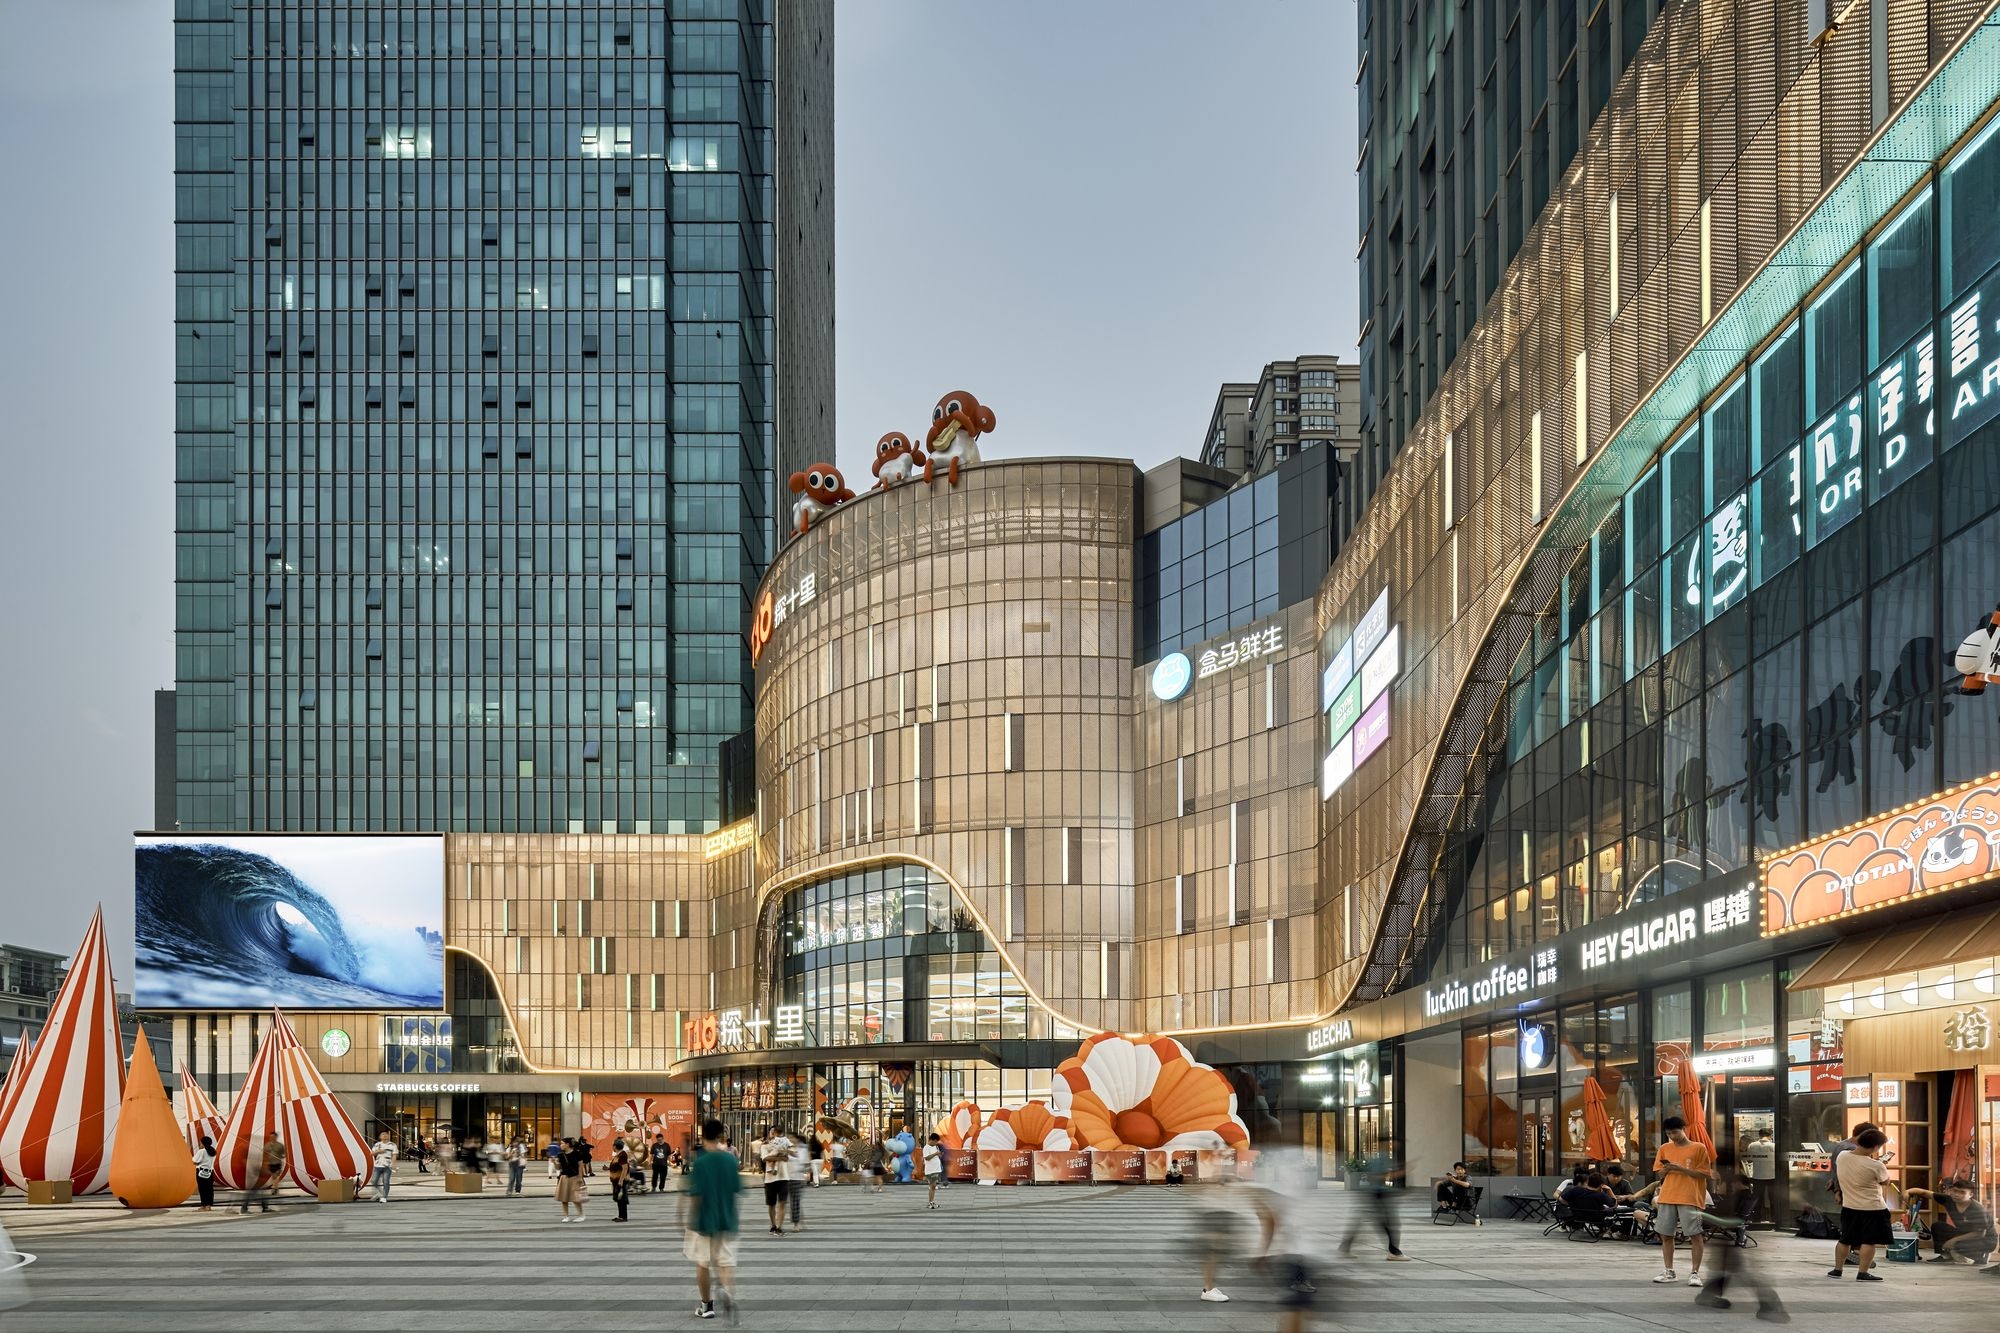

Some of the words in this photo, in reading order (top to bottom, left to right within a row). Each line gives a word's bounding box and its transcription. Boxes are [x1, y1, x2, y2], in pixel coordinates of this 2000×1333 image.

[1792, 434, 1906, 536] ORD
[775, 572, 817, 629] 探十里
[1199, 626, 1284, 678] 盒马鲜生
[1825, 856, 1914, 894] DAOTAN
[1582, 932, 1619, 970] HEY
[1621, 907, 1696, 959] SUGAR
[1704, 889, 1750, 934] 嘿糖
[1537, 948, 1557, 968] 瑞幸
[1537, 968, 1557, 986] 咖啡
[1426, 981, 1469, 1017] luckin
[1472, 965, 1528, 1004] coffee
[684, 1014, 718, 1052] T10
[721, 1005, 805, 1046] 探十里
[1307, 1020, 1351, 1051] LELECHA
[1943, 1005, 2000, 1051] 稻
[377, 1083, 439, 1092] STARBUCKS
[440, 1083, 480, 1092] COFFEE
